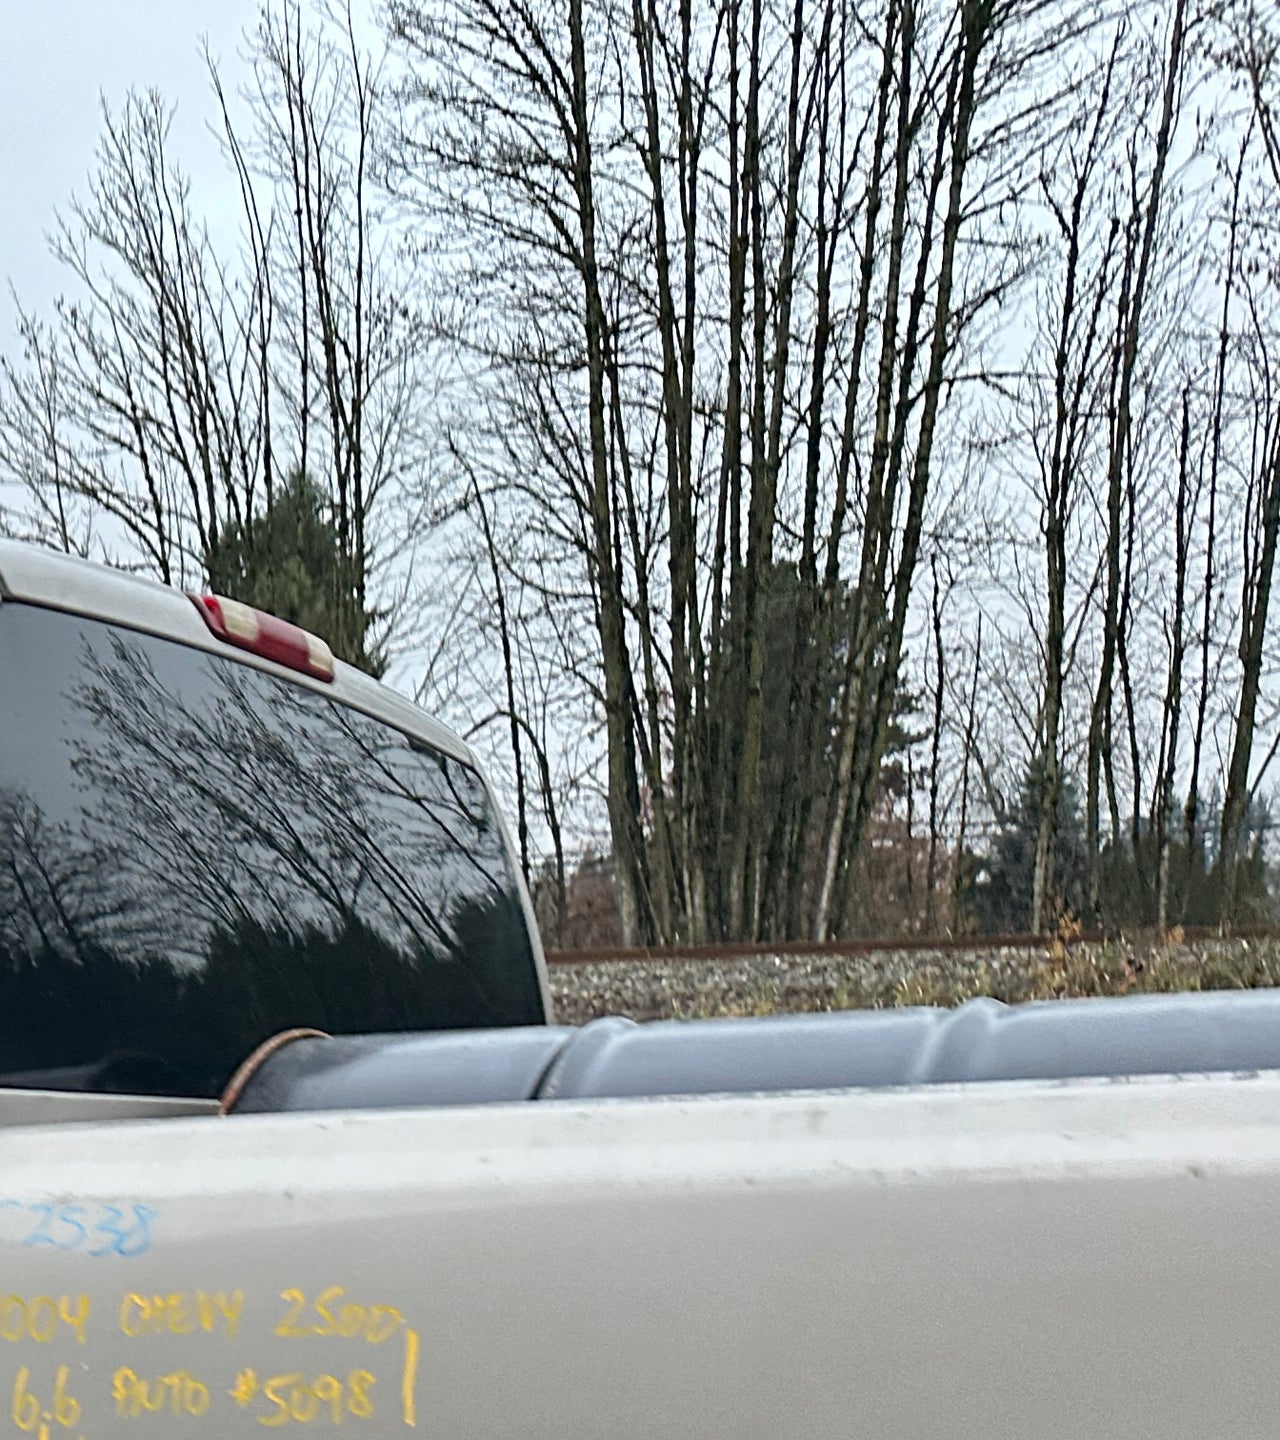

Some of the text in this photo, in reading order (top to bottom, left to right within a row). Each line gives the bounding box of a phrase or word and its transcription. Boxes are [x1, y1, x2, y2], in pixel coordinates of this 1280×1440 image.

[274, 1285, 408, 1344] 2500
[11, 1366, 82, 1431] 6.6
[113, 1366, 210, 1418] AUTO
